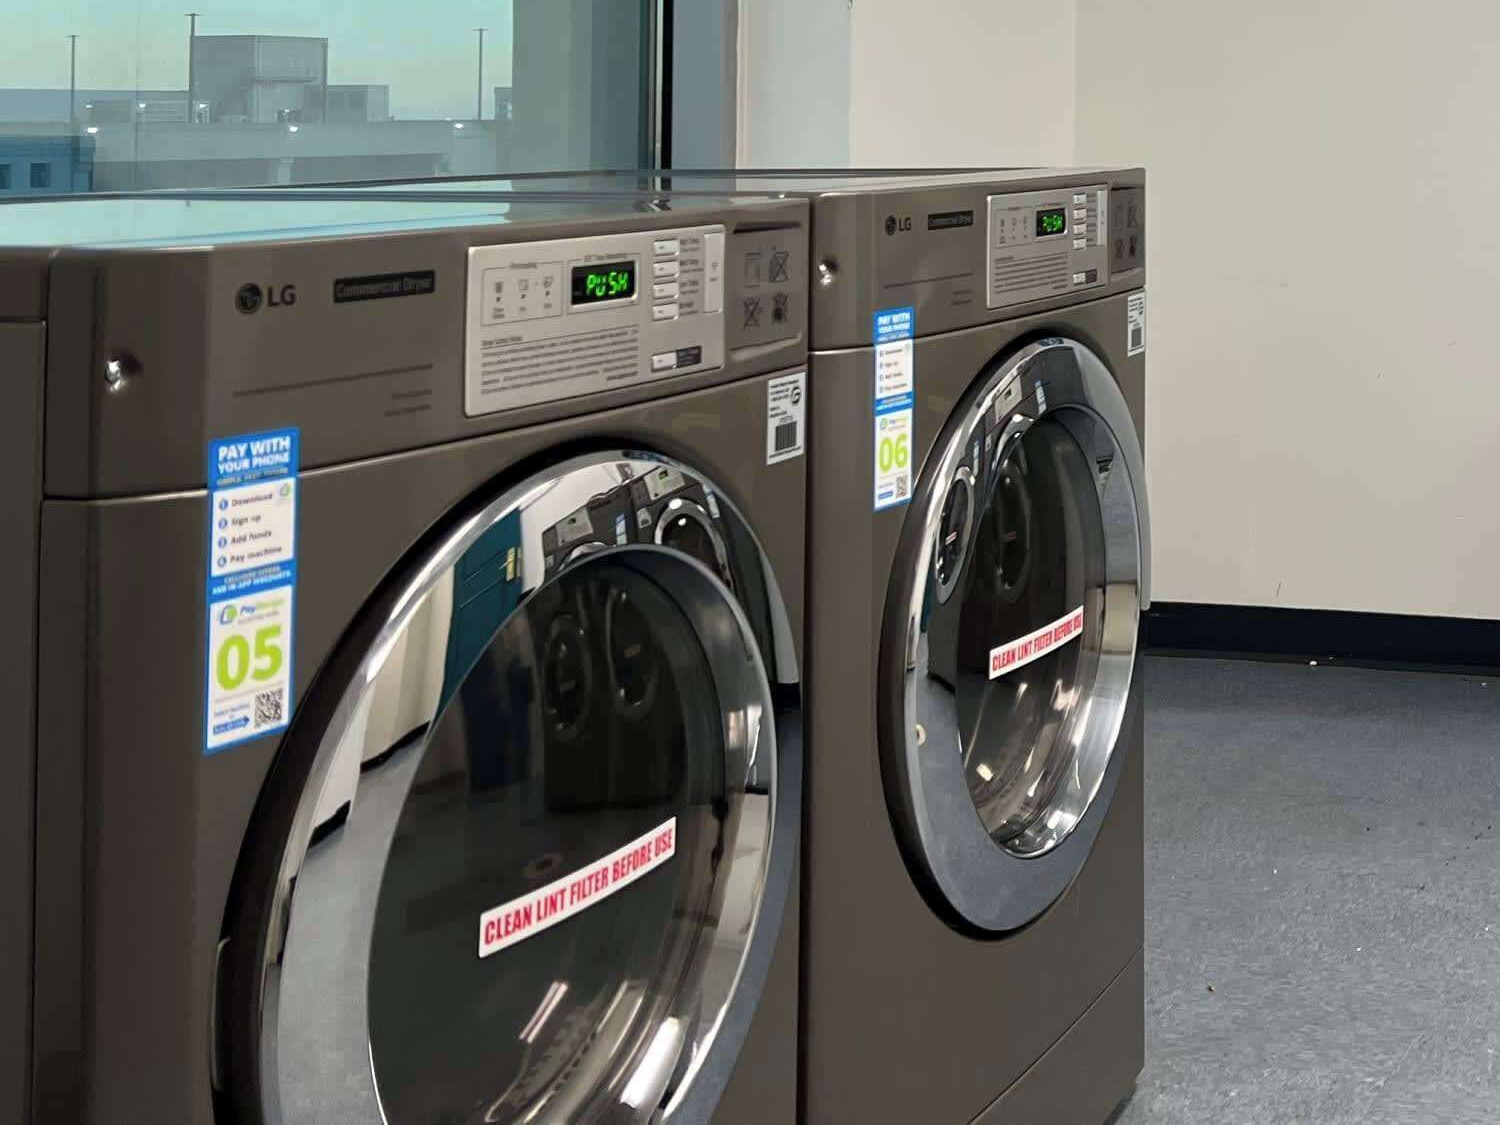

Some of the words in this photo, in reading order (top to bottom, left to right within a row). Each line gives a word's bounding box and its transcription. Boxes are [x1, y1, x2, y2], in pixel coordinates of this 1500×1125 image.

[898, 217, 912, 232] LG
[267, 284, 296, 307] LG
[586, 271, 628, 297] PUSH
[218, 444, 247, 461] PAY
[250, 436, 291, 457] WITH
[878, 432, 908, 473] 06
[217, 458, 249, 475] YOUR
[251, 451, 290, 468] PHONE
[230, 534, 247, 545] Add
[230, 553, 245, 564] Pay
[992, 648, 1016, 672] CLEAN
[1017, 640, 1033, 661] LINT
[1033, 630, 1053, 653] FILTER
[1054, 618, 1073, 643] BEFORE
[216, 625, 283, 691] 05
[484, 903, 532, 946] CLEAN
[536, 887, 567, 922] LINT
[569, 867, 609, 906] FILTER
[612, 841, 652, 885] BEFORE
[654, 828, 673, 858] USE
